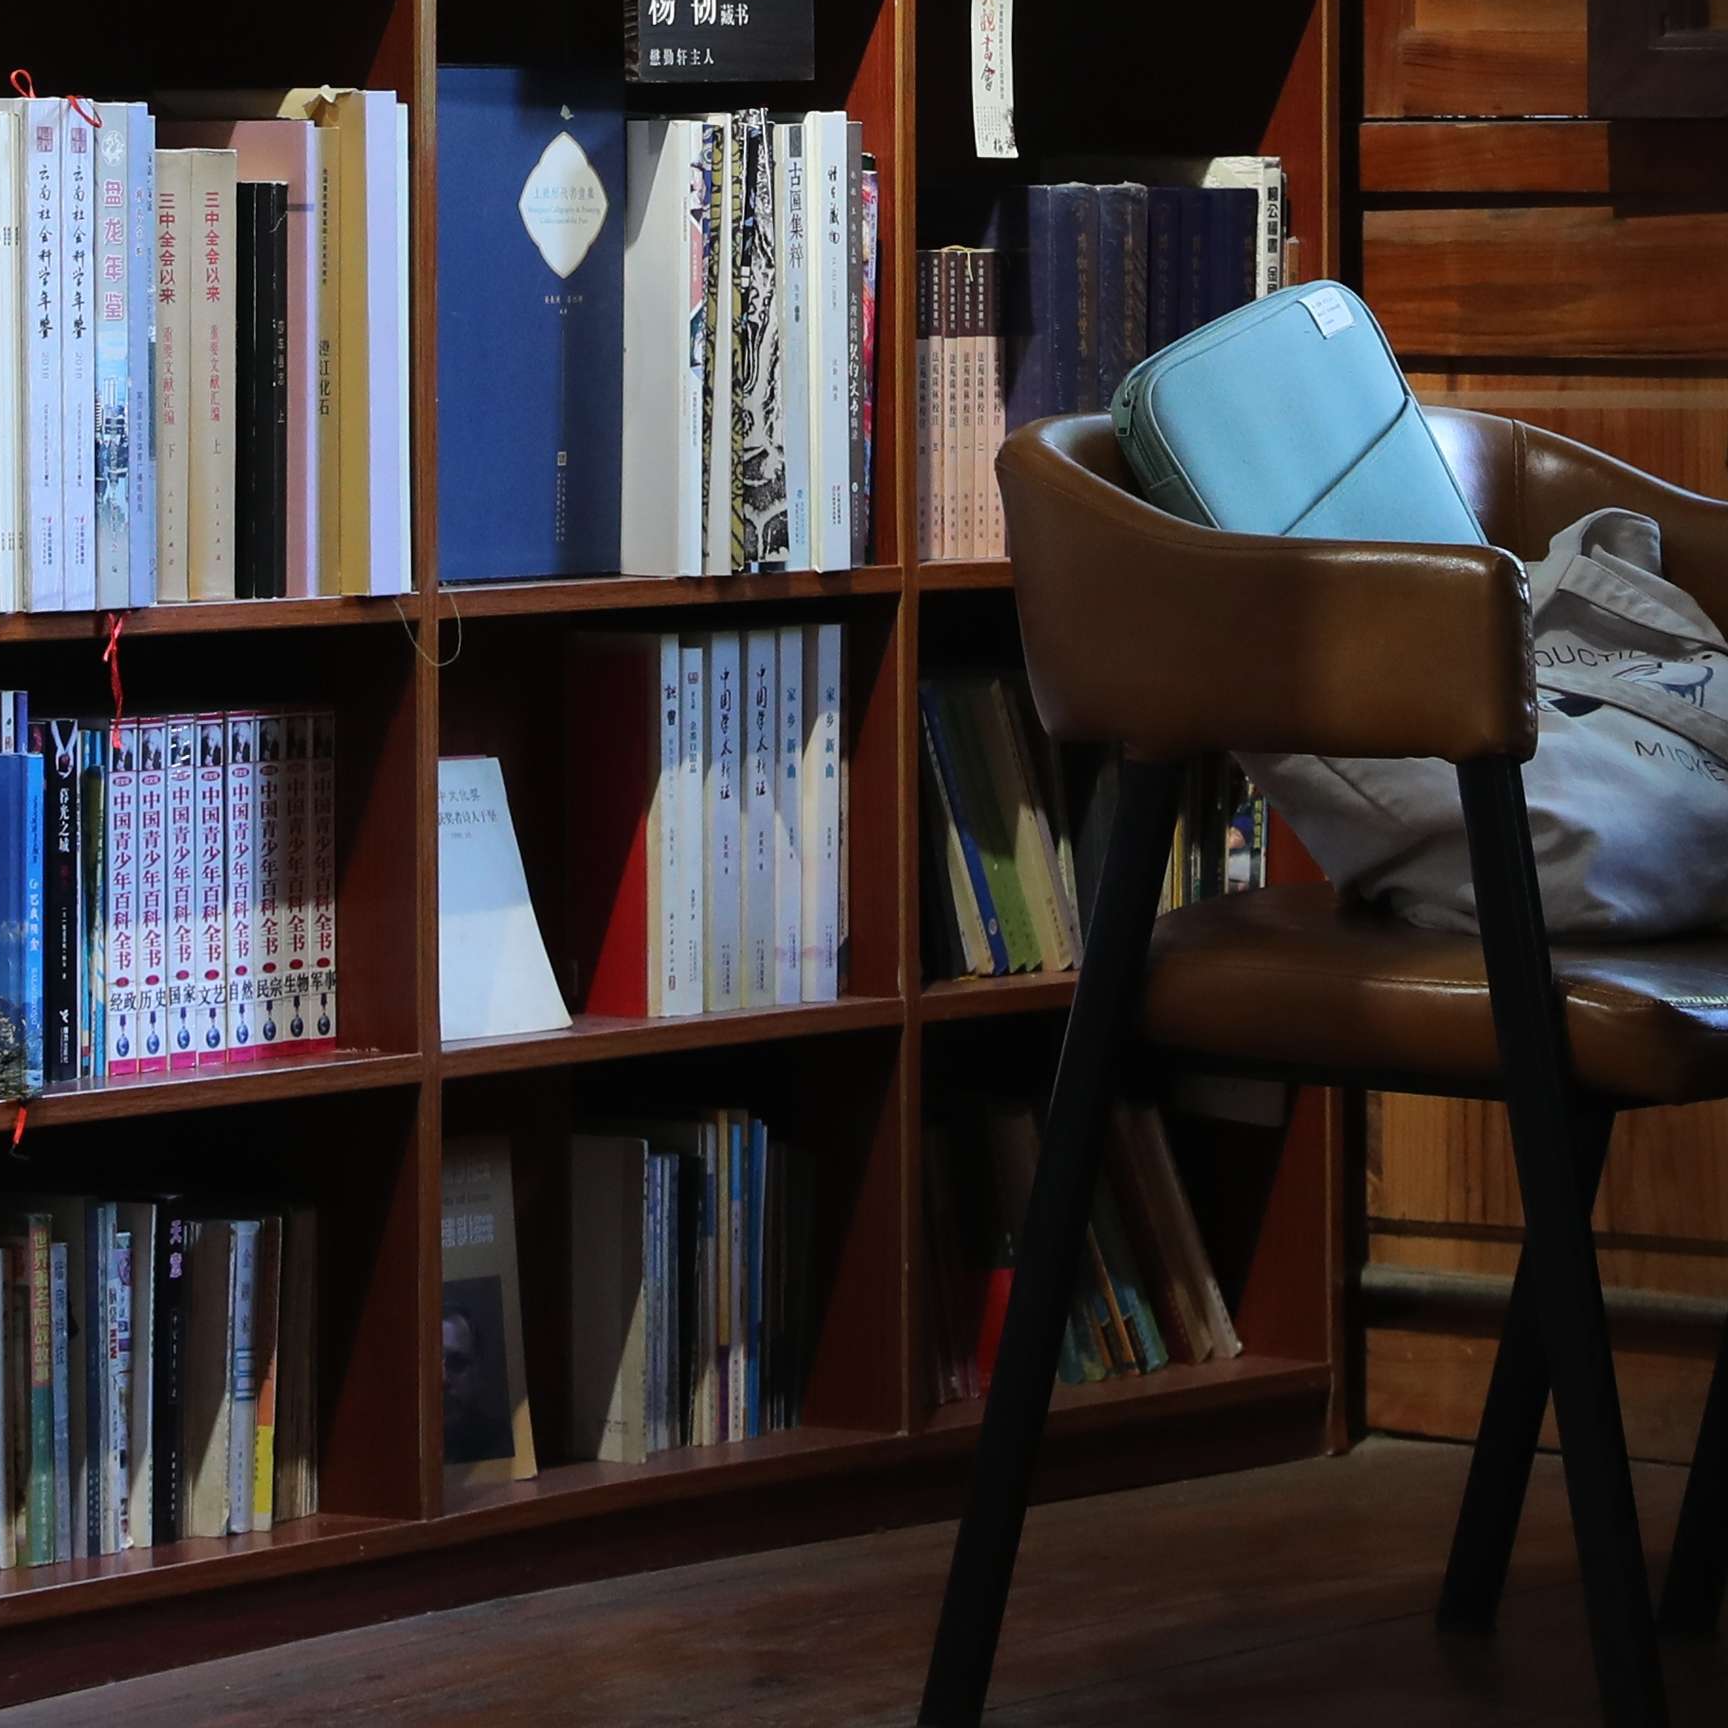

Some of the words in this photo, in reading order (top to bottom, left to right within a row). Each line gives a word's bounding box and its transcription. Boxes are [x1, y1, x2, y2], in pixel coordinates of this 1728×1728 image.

[158, 189, 177, 306] 三中全会以来
[203, 189, 222, 305] 三中全会以来
[113, 792, 131, 971] 中国青少年百科全书
[143, 790, 161, 969] 中国青少年百科全书
[172, 787, 190, 963] 中国青少年百科全书
[201, 787, 221, 962] 中国青少年百科全书
[232, 783, 249, 959] 中国青少年百科全书
[260, 781, 278, 955] 中国青少年百科全书
